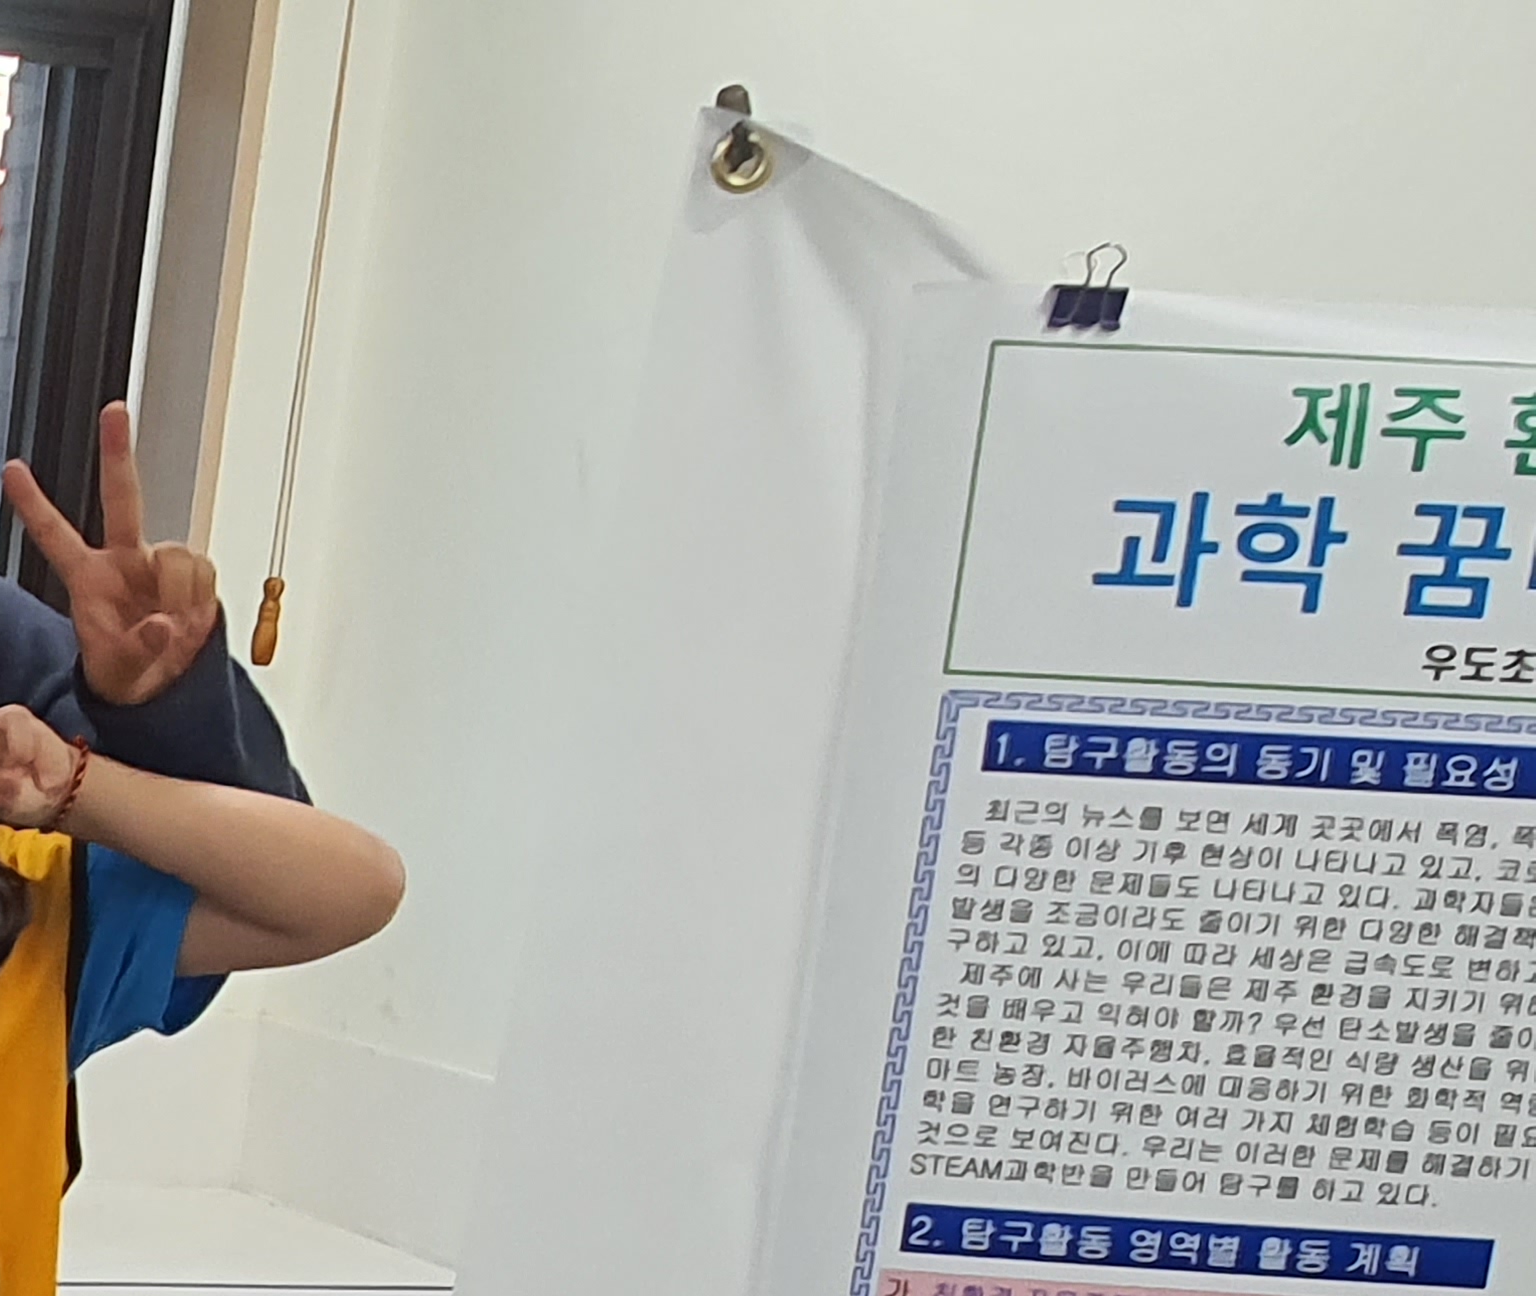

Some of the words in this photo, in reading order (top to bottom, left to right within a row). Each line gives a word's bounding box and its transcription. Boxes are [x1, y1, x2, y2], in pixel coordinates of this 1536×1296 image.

[1283, 382, 1467, 472] 제주
[1091, 490, 1348, 614] 과학
[1396, 503, 1536, 619] 꿈
[996, 733, 1027, 766] 1.
[1043, 733, 1239, 778] 탐구활동의
[1256, 744, 1333, 782] 동기
[1349, 750, 1385, 785] 및
[1402, 752, 1519, 791] 필요성
[985, 800, 1068, 825] 최근의
[1082, 805, 1163, 831] 뉴스를
[1176, 810, 1230, 834] 보면
[1241, 812, 1298, 837] 세계
[1311, 814, 1422, 843] 곳곳에서
[909, 1153, 1113, 1187] STEAM과학반을
[1126, 1167, 1208, 1193] 만들어
[1219, 1173, 1299, 1199] 탐구를
[1312, 1178, 1364, 1202] 하고
[1377, 1182, 1438, 1207] 있다.
[917, 1120, 998, 1148] 것으로
[1010, 1128, 1127, 1157] 보여진다.
[1142, 1134, 1223, 1163] 우리는
[1235, 1142, 1316, 1168] 이러한
[1328, 1146, 1408, 1174] 문제를
[1422, 1151, 1528, 1180] 해결하기
[908, 1215, 943, 1247] 2.
[961, 1218, 1112, 1258] 탐구활동
[1129, 1227, 1238, 1268] 영역별
[1258, 1236, 1330, 1272] 활동
[1349, 1242, 1421, 1277] 계획
